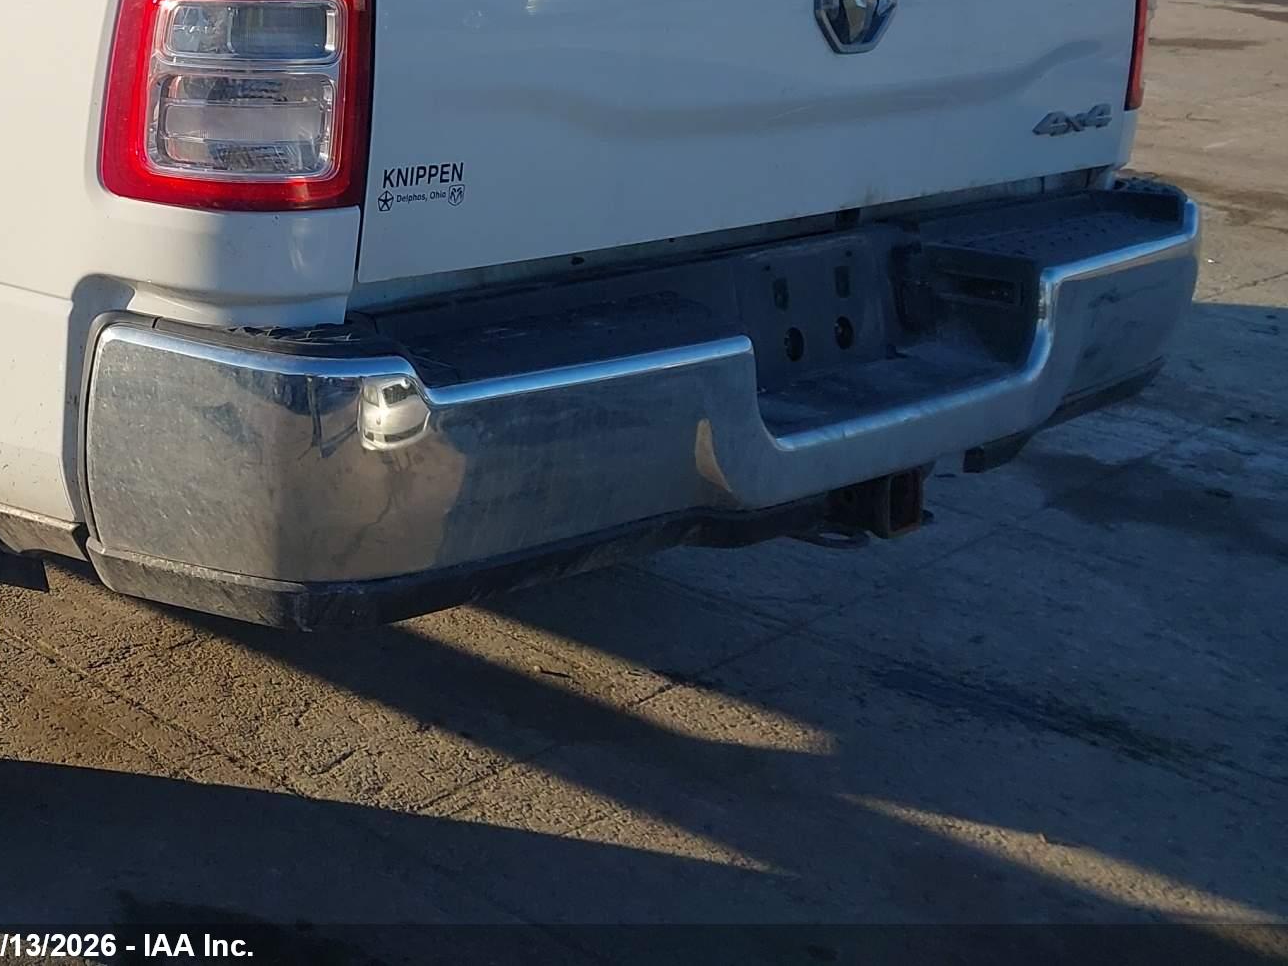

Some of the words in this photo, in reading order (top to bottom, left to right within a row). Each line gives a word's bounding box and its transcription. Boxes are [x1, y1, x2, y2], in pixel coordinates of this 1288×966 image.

[382, 162, 464, 189] KNIPPEN
[396, 193, 428, 205] Delphos,
[429, 190, 447, 201] Ohio
